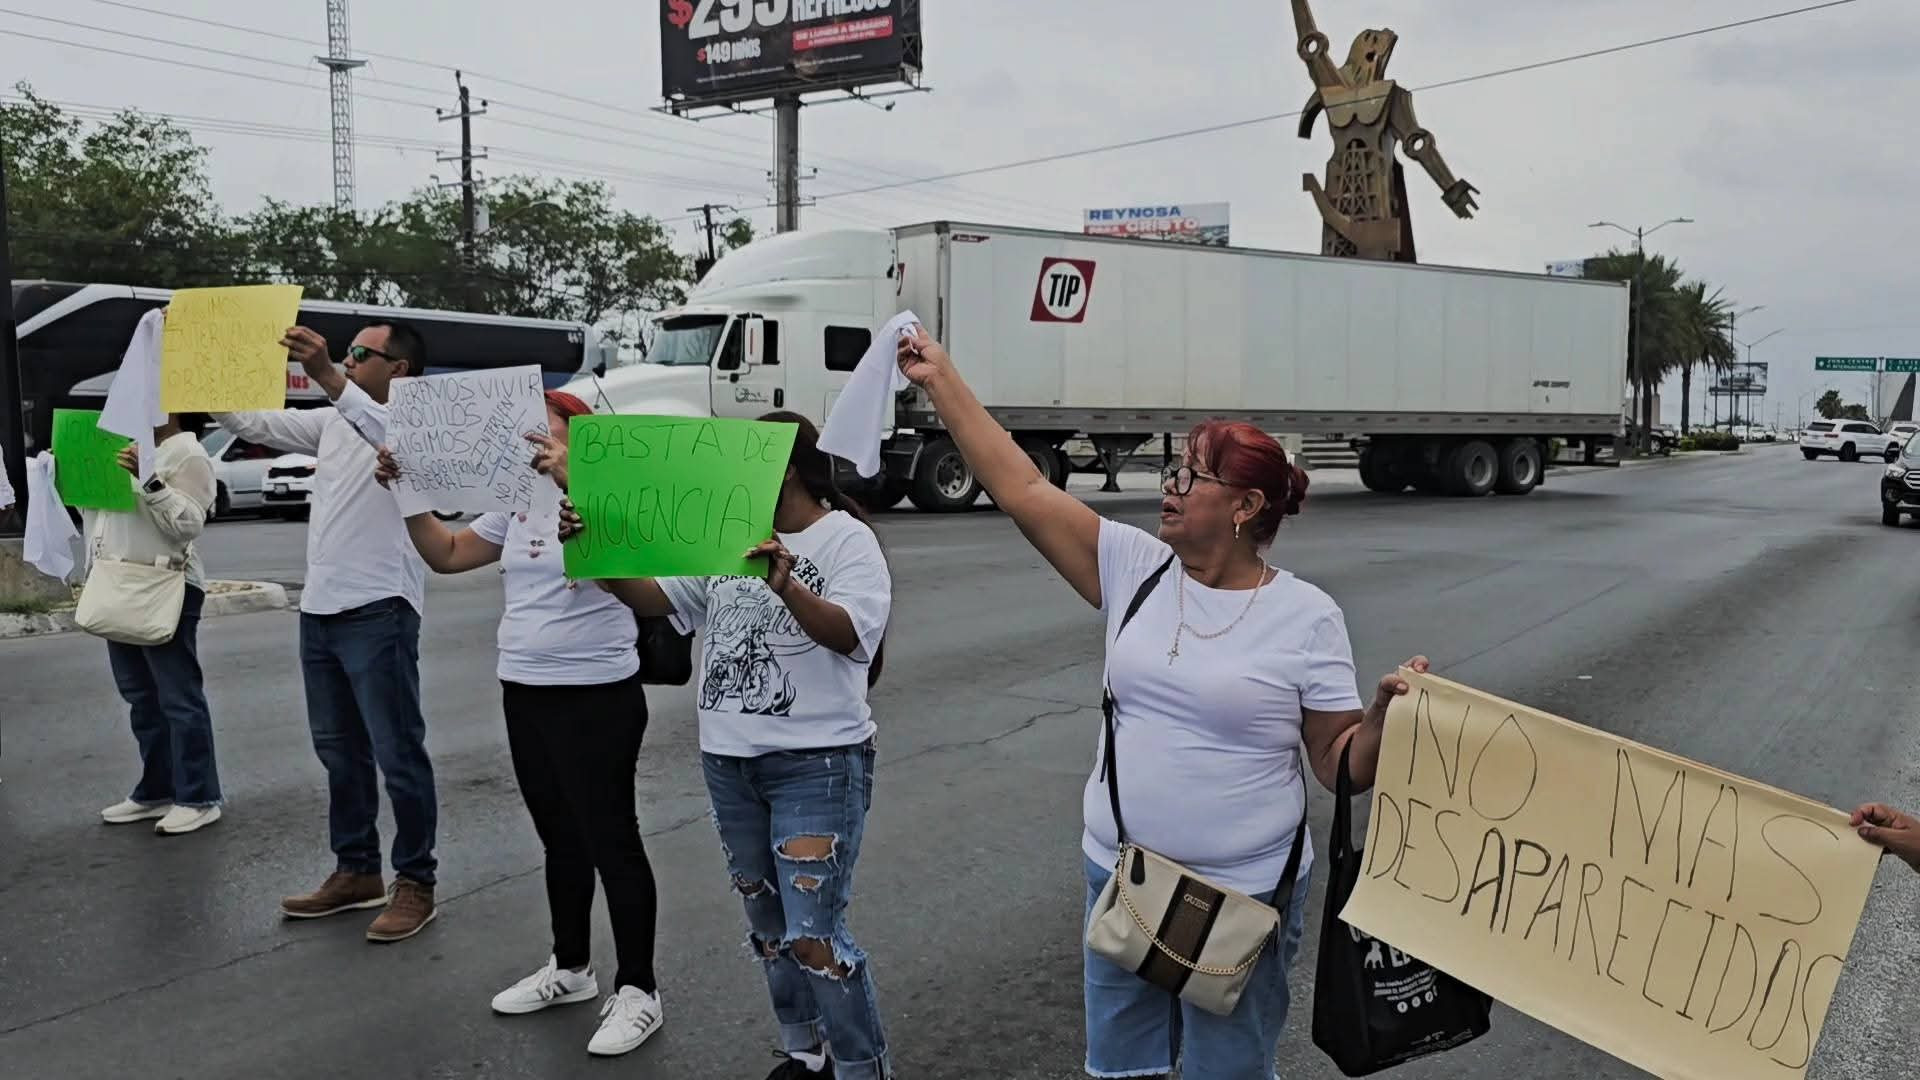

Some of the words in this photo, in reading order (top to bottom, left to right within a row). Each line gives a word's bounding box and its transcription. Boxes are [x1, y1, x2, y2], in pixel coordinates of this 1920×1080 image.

[696, 41, 731, 64] $149
[1089, 206, 1182, 220] REYNOSA
[1048, 273, 1081, 307] TIP
[478, 373, 542, 400] VIVIR
[575, 422, 723, 464] BASTA
[744, 428, 777, 463] DE
[576, 483, 755, 559] VIOLENCIA
[1406, 688, 1538, 821] NO
[1609, 748, 1840, 926] MAS
[1366, 791, 1845, 1070] DESAPARECIDOS
